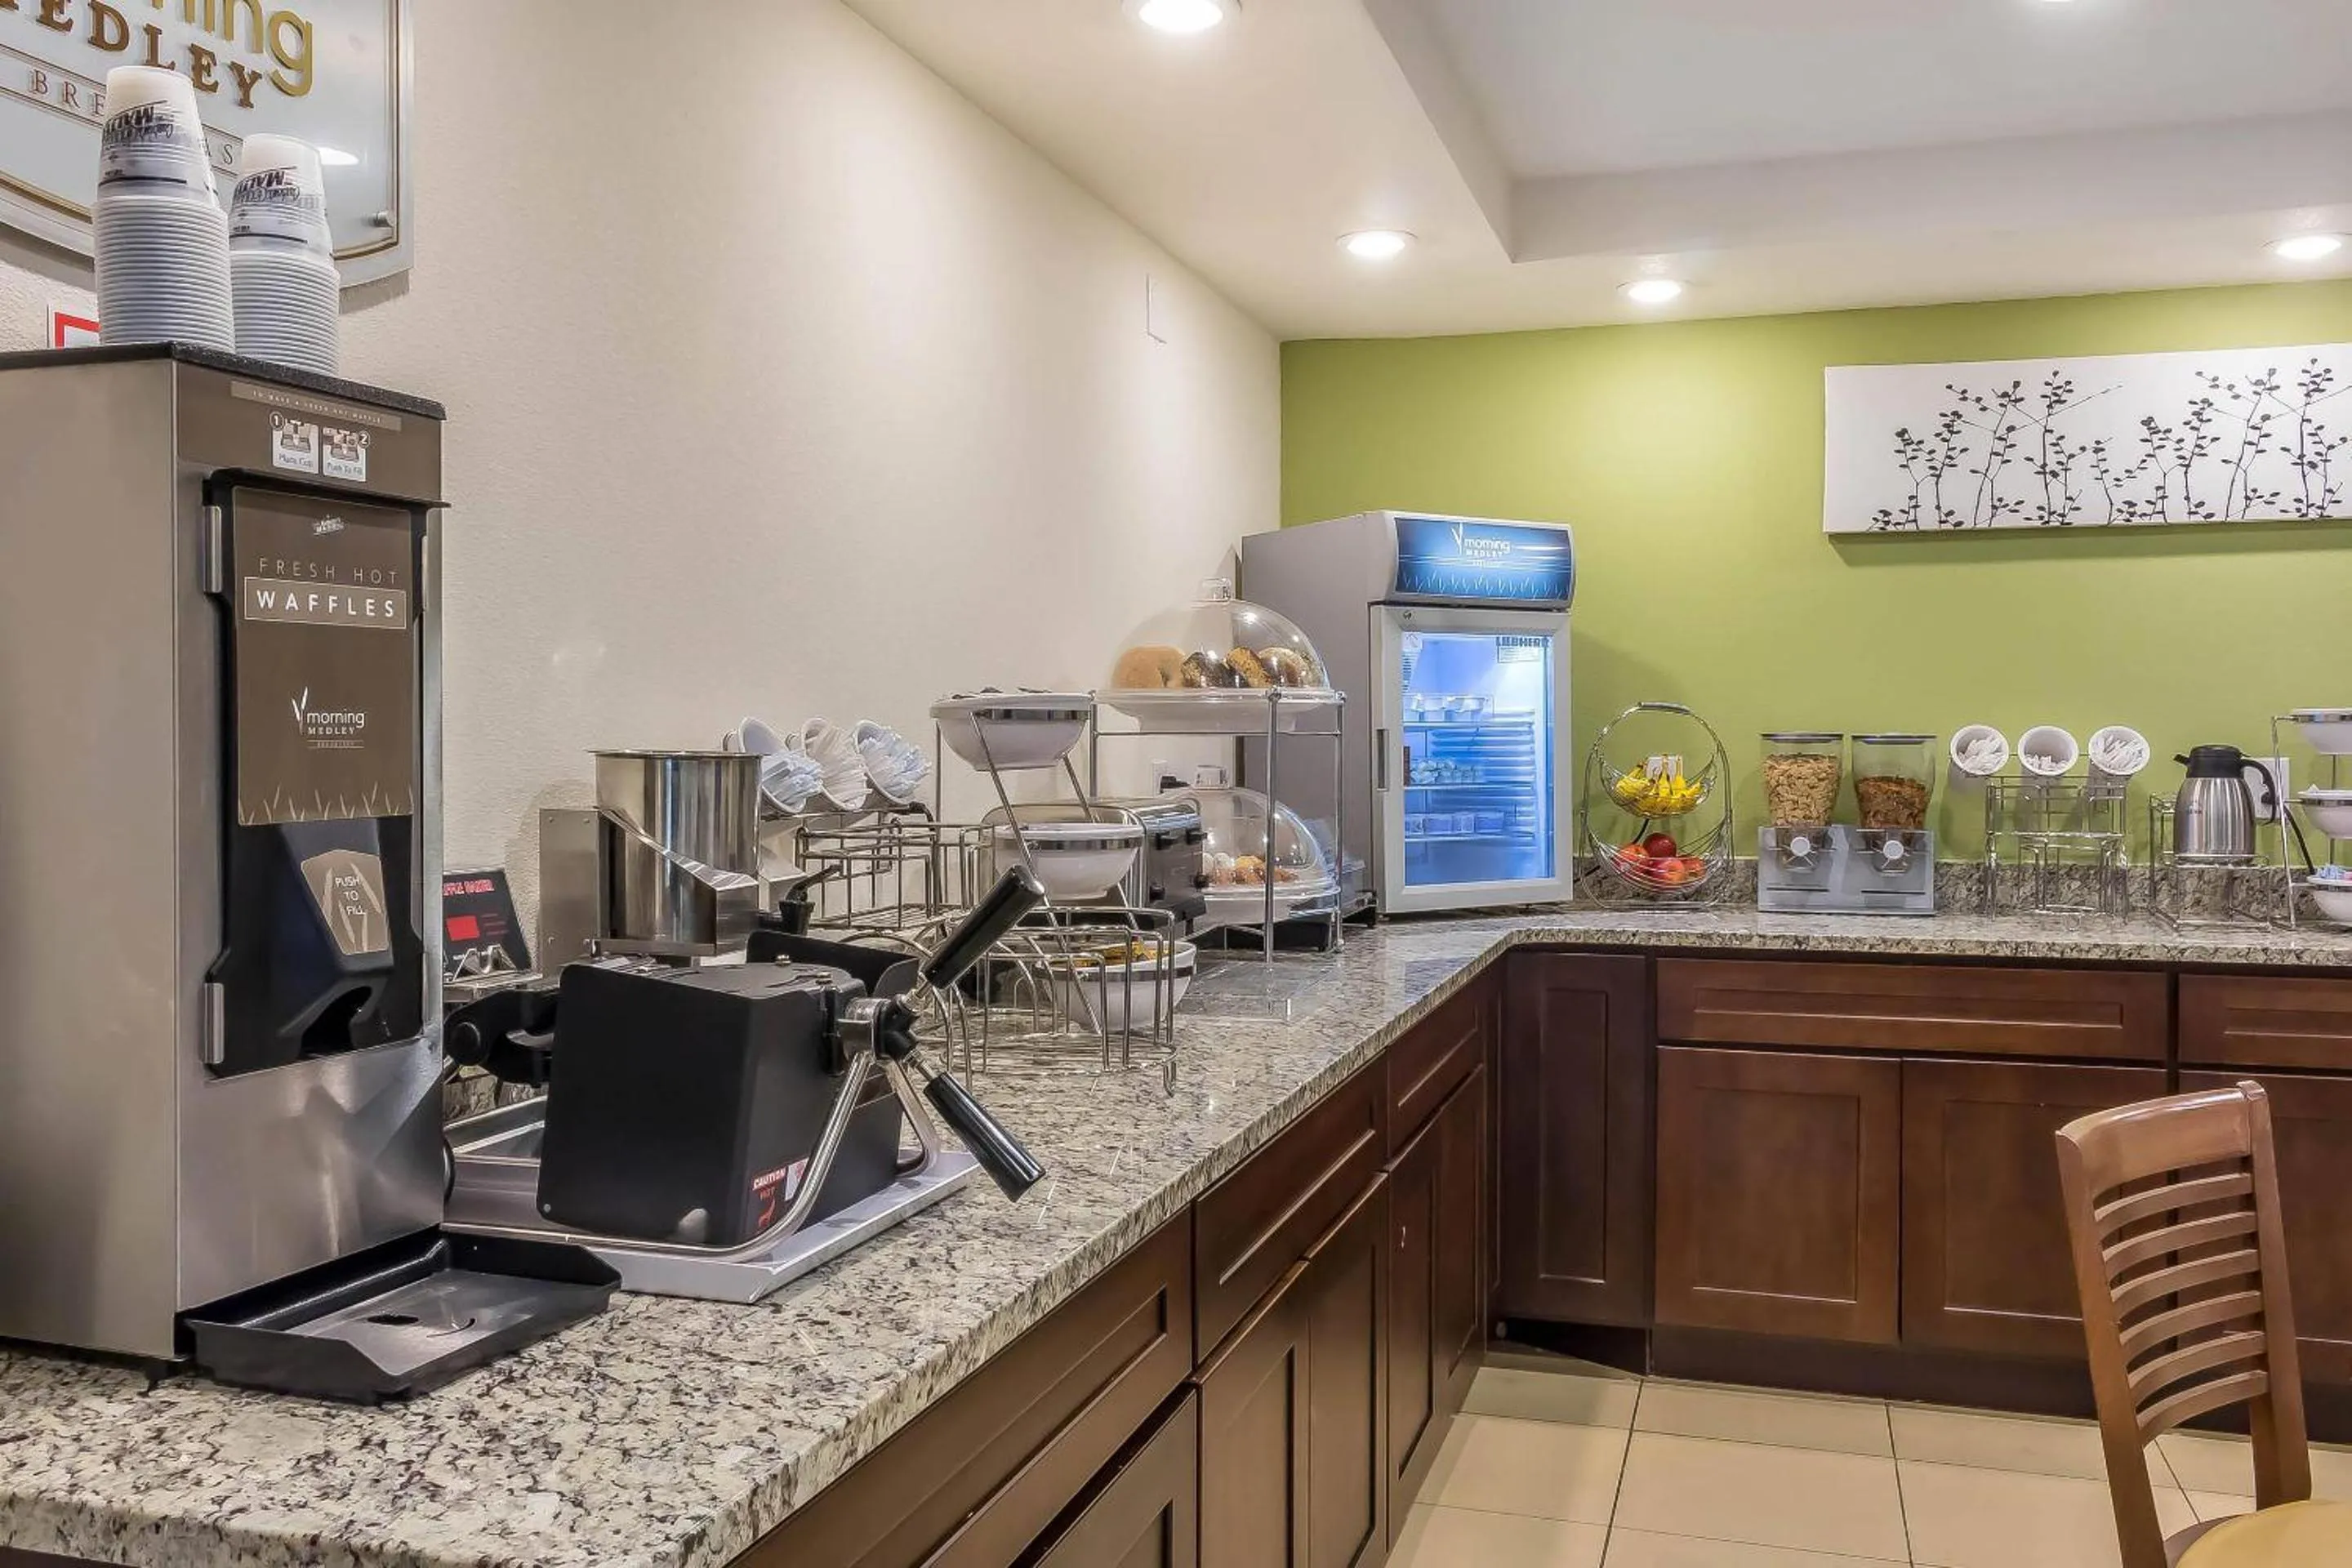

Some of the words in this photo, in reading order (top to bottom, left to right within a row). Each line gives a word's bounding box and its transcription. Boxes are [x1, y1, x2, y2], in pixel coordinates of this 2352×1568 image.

[0, 0, 262, 109] EDLEY
[259, 557, 336, 581] FRESH
[354, 567, 399, 585] HOT
[256, 589, 394, 617] WAFFLES
[307, 708, 365, 728] morning
[308, 727, 355, 735] MEDLEY
[335, 875, 361, 888] PUSH
[343, 890, 359, 901] TO
[346, 904, 367, 915] FILL
